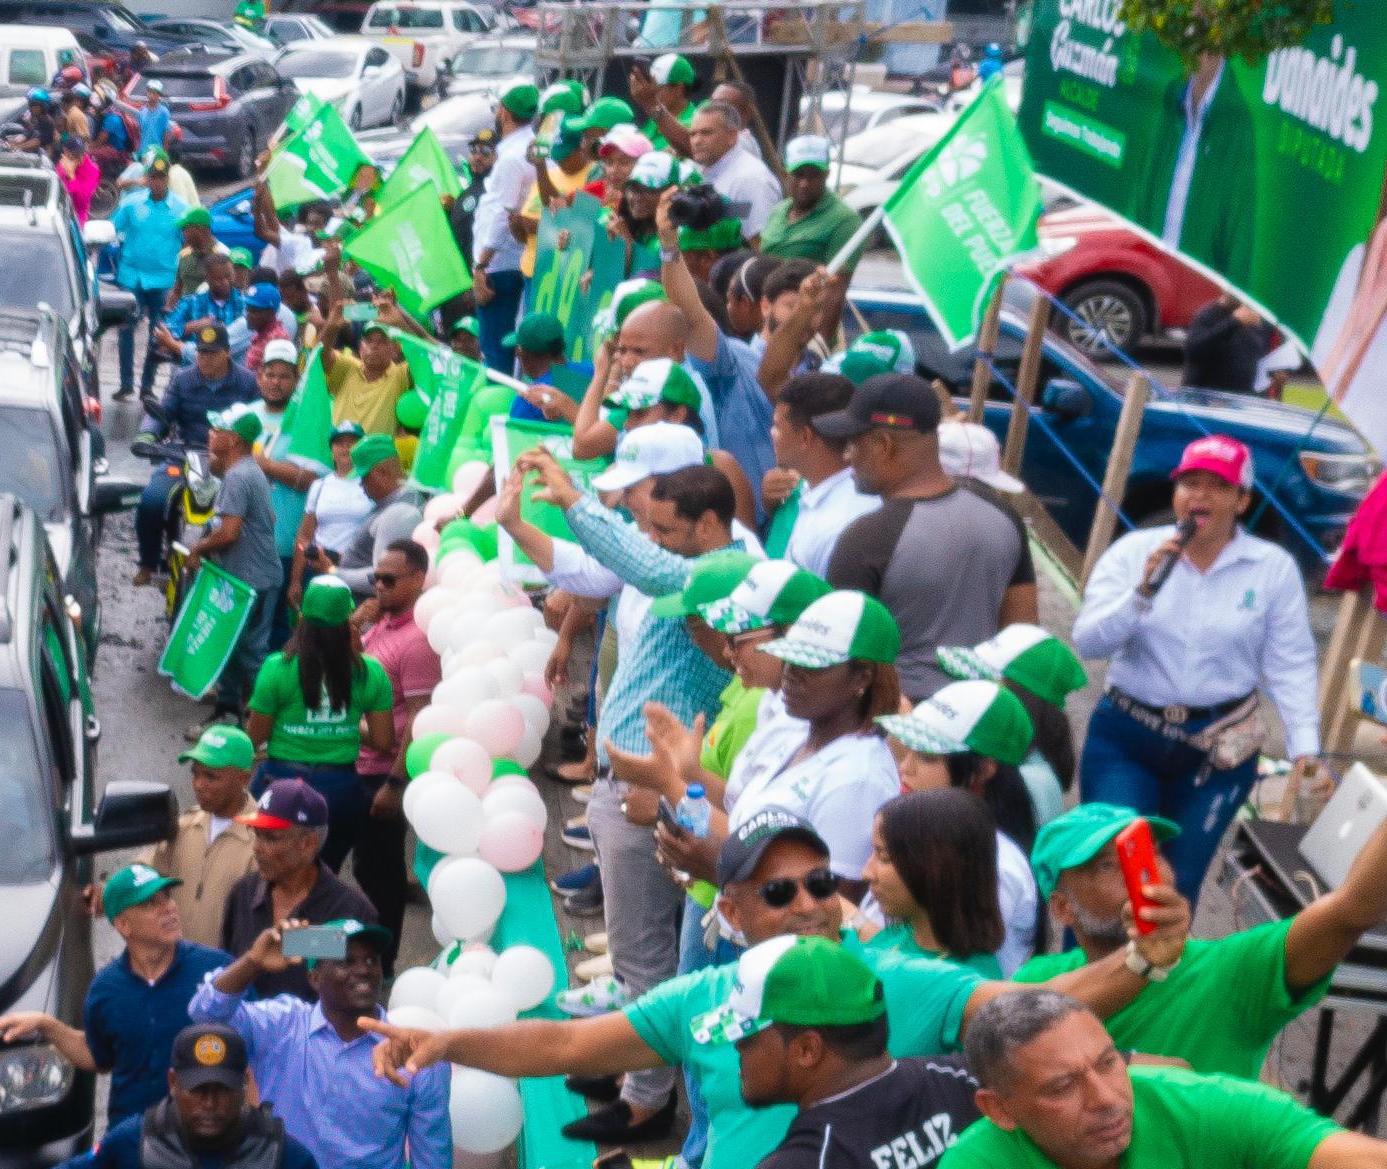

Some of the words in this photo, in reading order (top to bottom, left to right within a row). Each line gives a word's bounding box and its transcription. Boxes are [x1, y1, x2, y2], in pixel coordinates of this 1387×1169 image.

[1050, 21, 1118, 88] Guzmán
[941, 205, 969, 237] DEL
[738, 810, 799, 842] CARLOS
